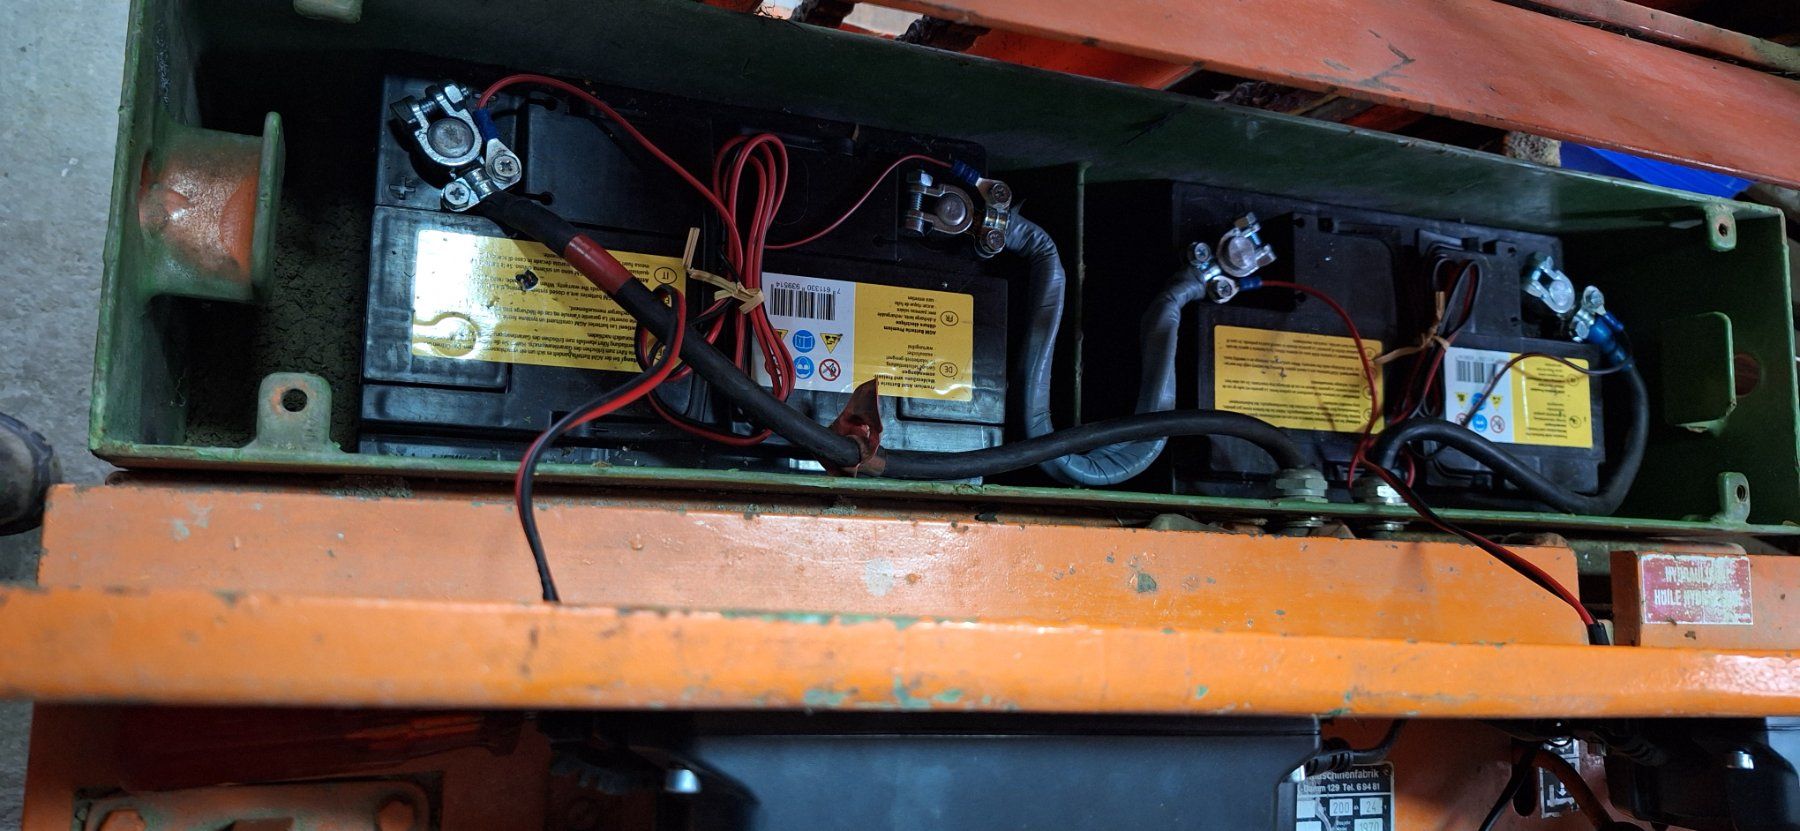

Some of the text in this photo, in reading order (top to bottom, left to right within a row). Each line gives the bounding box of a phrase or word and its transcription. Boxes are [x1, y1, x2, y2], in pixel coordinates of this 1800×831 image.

[662, 272, 669, 280] IT
[776, 281, 800, 289] 939514
[806, 284, 831, 292] 611330
[945, 314, 954, 322] FR
[944, 366, 953, 374] DE
[1328, 783, 1340, 792] 129
[1342, 783, 1356, 792] Tel.
[1333, 802, 1350, 814] 200
[1366, 800, 1376, 813] 24
